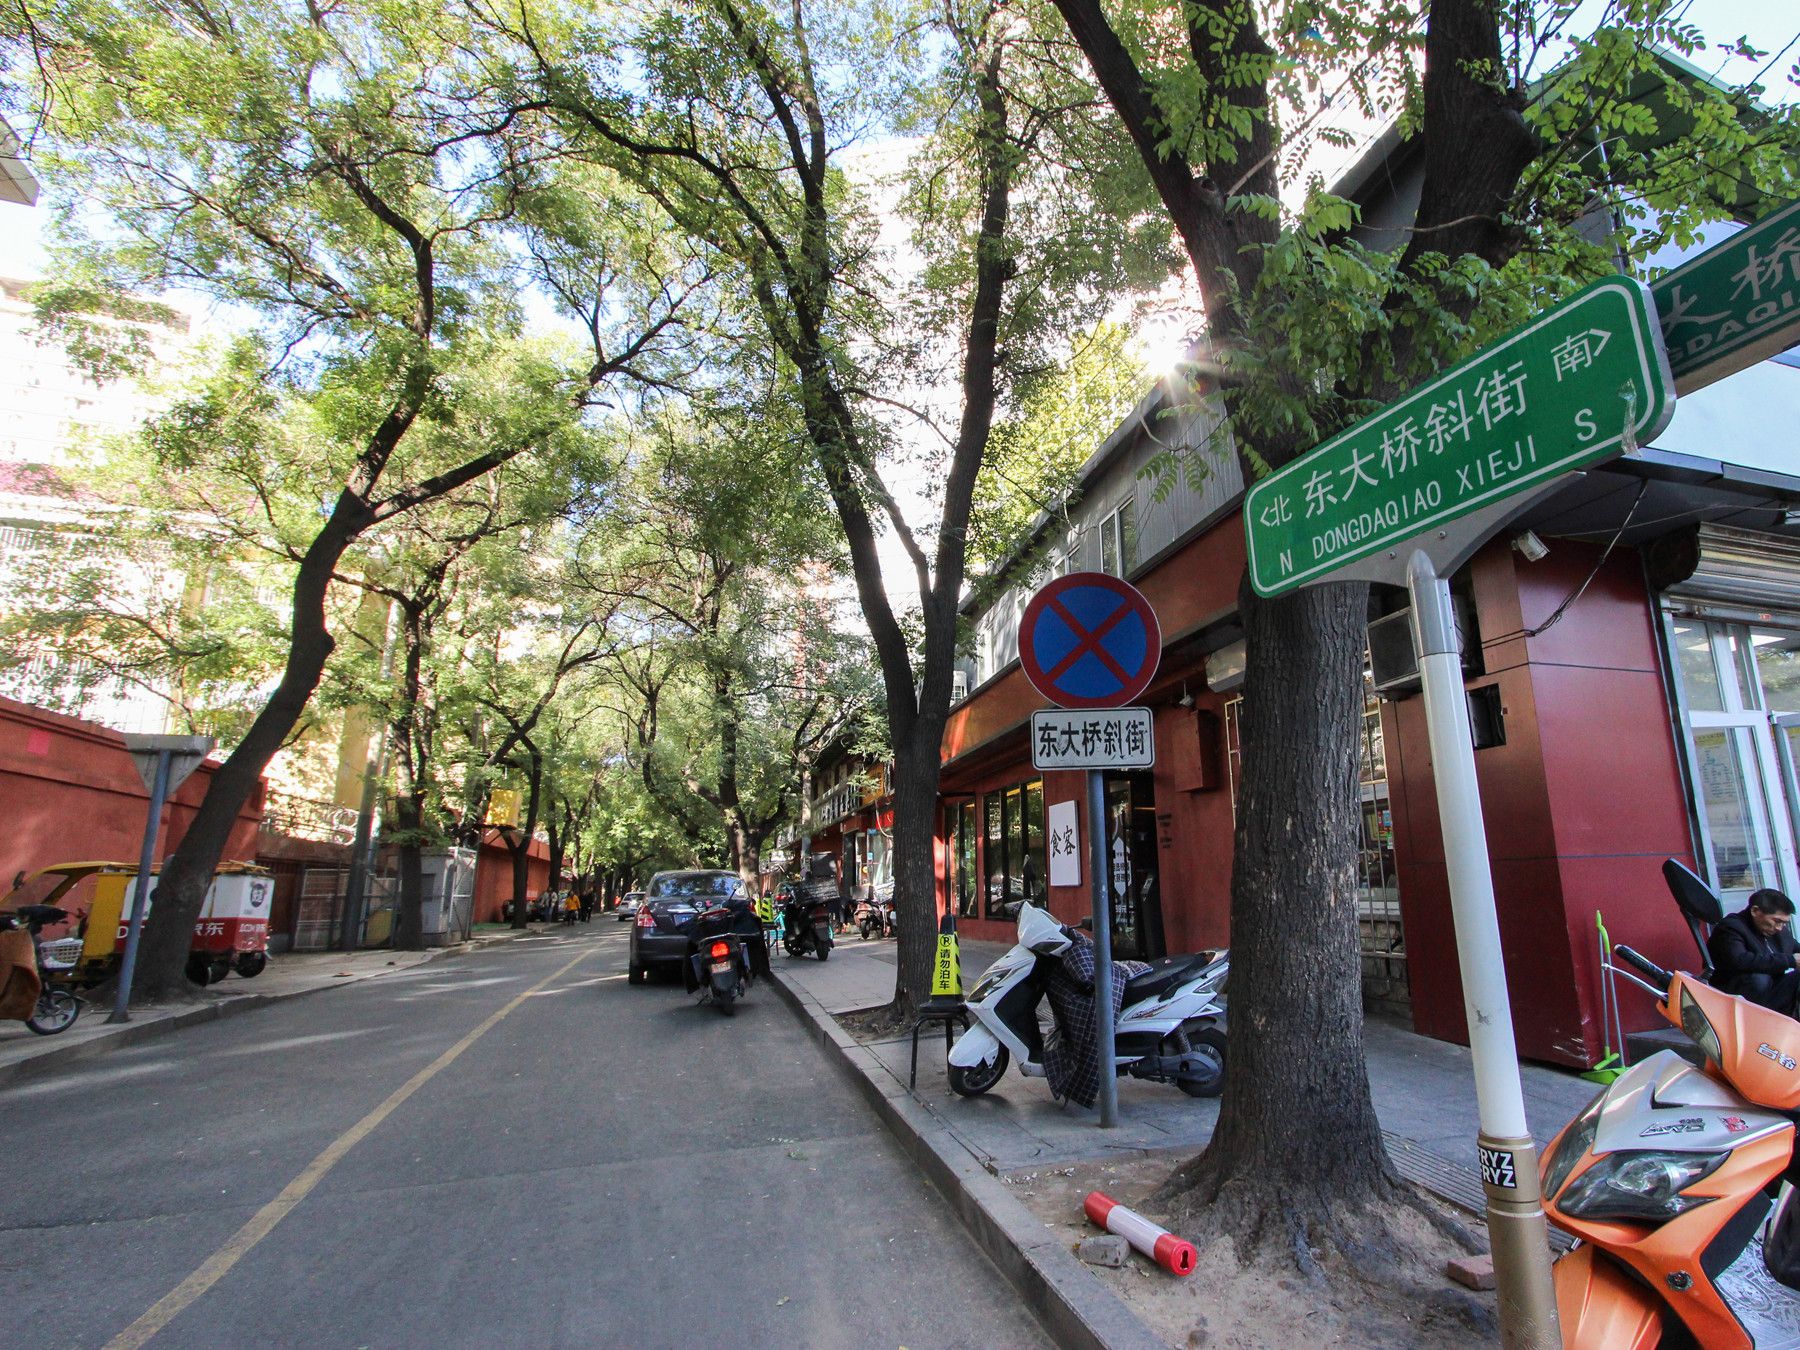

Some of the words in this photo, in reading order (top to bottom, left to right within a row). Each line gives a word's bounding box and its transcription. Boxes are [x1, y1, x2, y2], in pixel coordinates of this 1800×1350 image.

[1269, 495, 1293, 526] 北
[1303, 360, 1528, 519] 东大桥斜街
[1550, 331, 1593, 382] 南
[1279, 549, 1293, 576] N
[1312, 480, 1441, 560] DONGDAQIAO
[1456, 434, 1536, 496] XIEJI
[1574, 408, 1597, 442] S
[1038, 720, 1148, 758] 东大桥斜街
[1051, 825, 1076, 858] 食客
[939, 948, 951, 990] 请勿泊车
